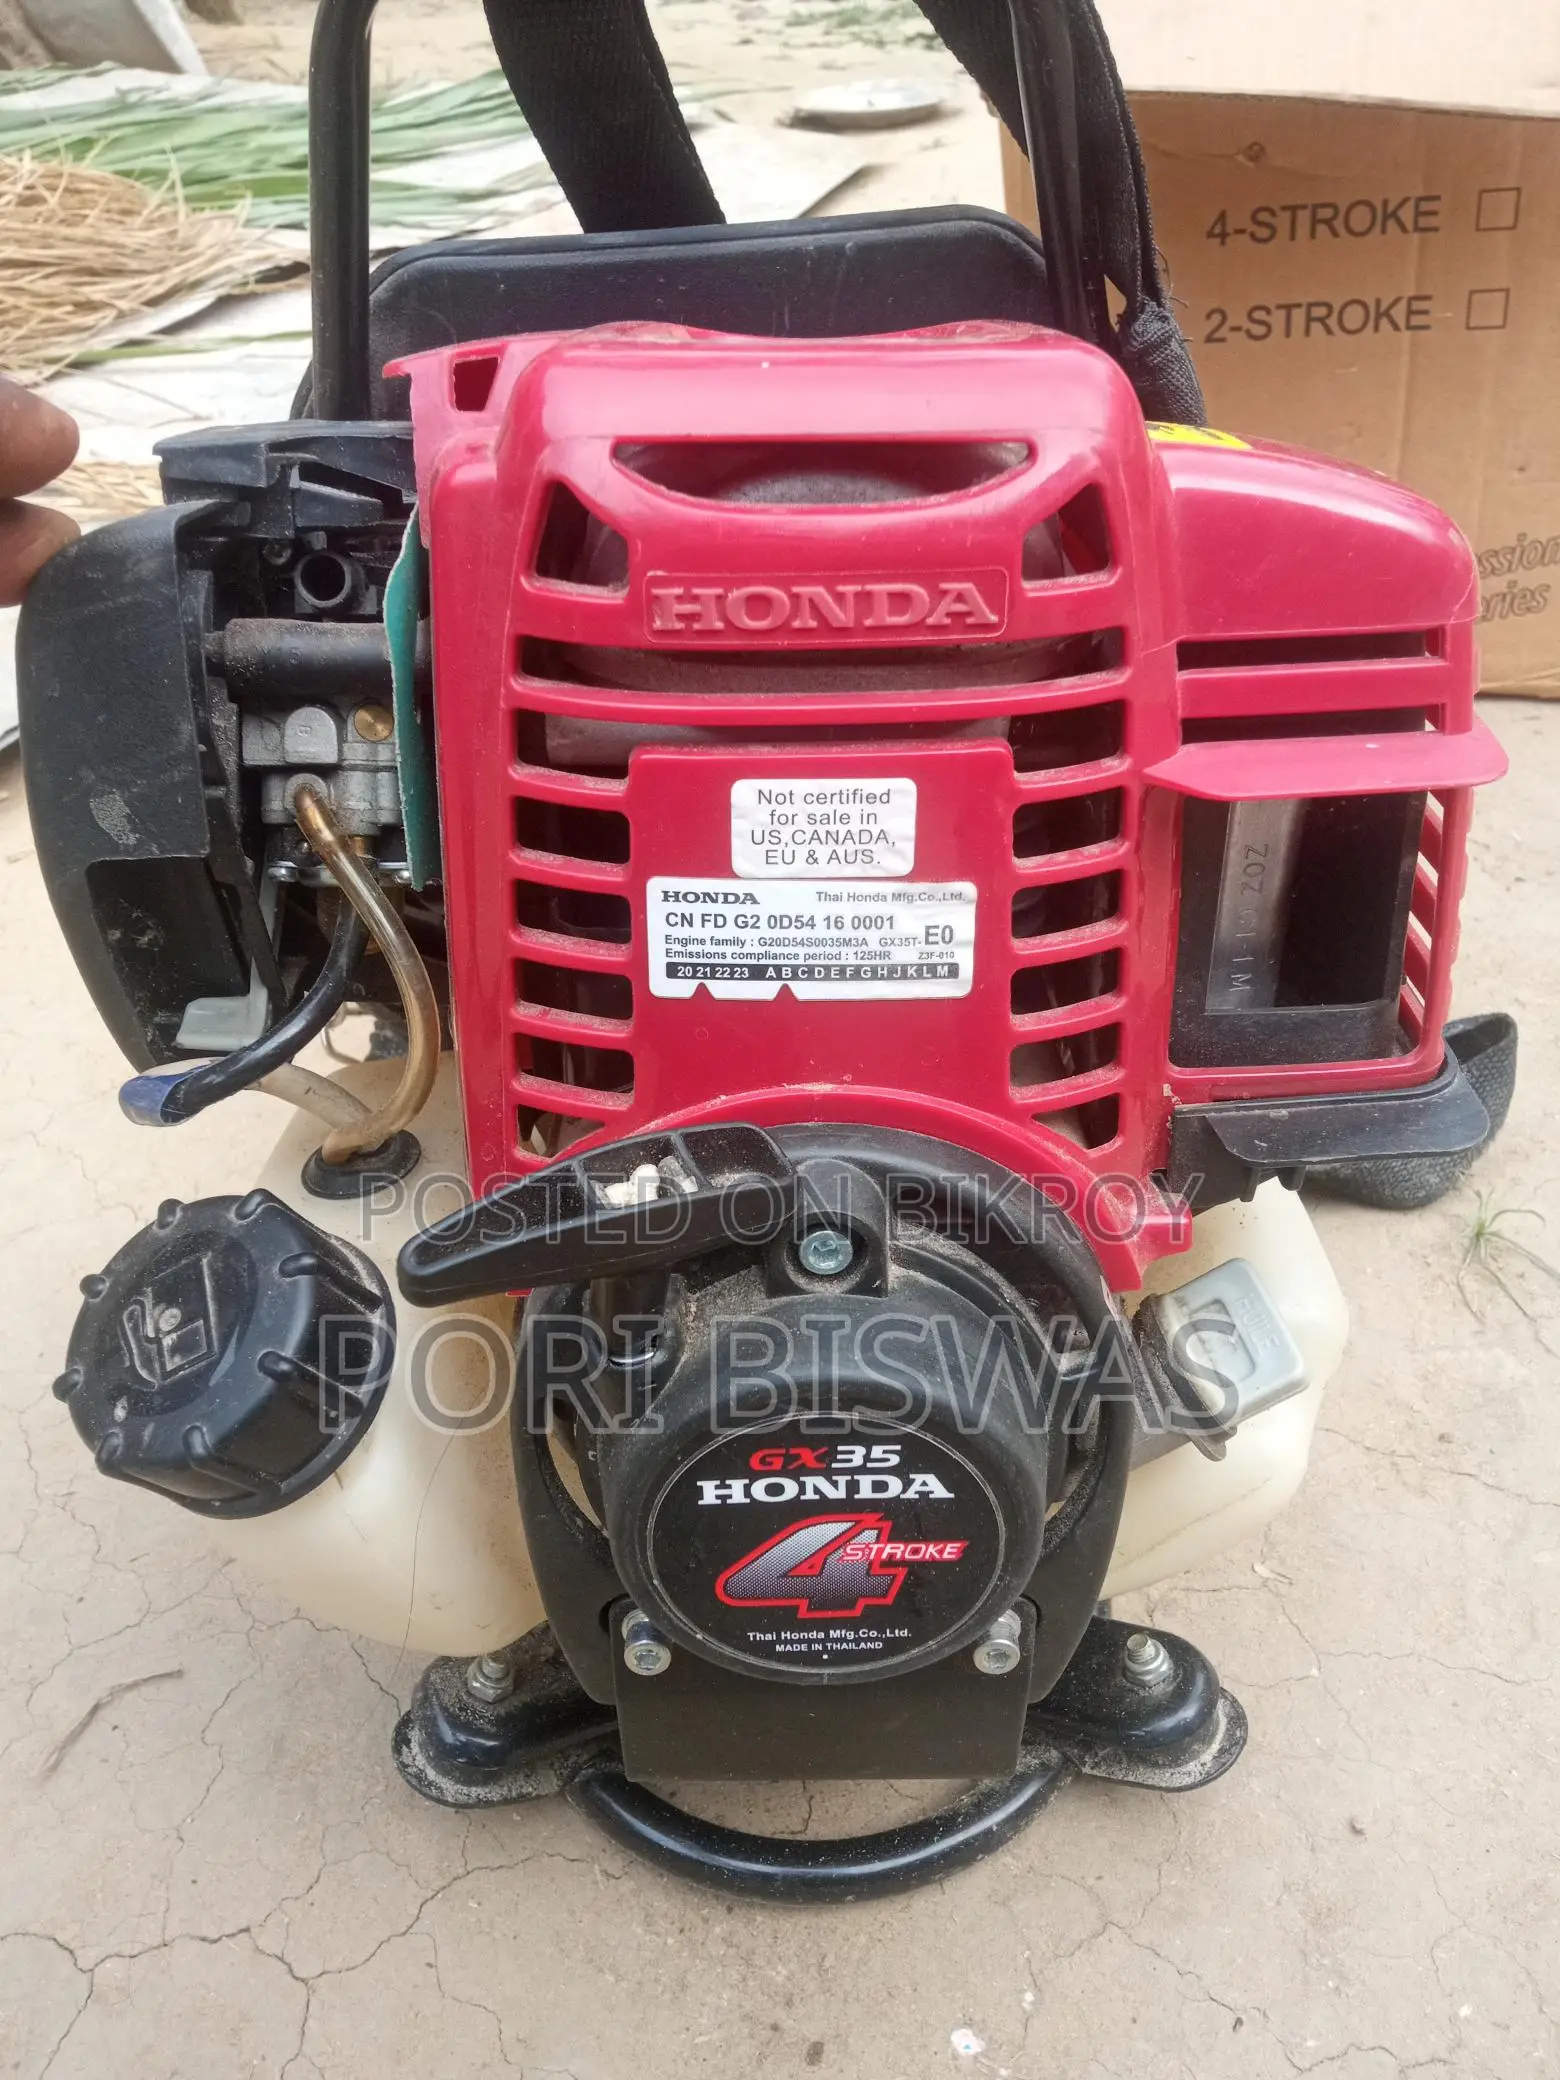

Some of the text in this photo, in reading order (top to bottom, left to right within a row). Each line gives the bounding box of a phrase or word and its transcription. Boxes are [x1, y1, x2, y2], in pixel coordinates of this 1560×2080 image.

[1205, 194, 1442, 247] 4-STROKE
[1203, 294, 1434, 344] 2-STROKE
[1476, 531, 1560, 580] ssion
[651, 581, 999, 632] HONDA
[757, 787, 891, 806] Not certified
[769, 808, 878, 826] for sale in
[750, 829, 898, 850] US,CANADA,
[765, 848, 882, 866] EU & AUS.
[661, 890, 967, 906] HONDA Thai Honda Mfg.Co.,Ltd.
[665, 912, 896, 931] CN FD G2 0D54 16 0001
[665, 934, 707, 948] Engine
[709, 935, 747, 948] family
[758, 936, 869, 948] G20D54S0035M3A
[665, 948, 727, 960] Emissions
[731, 950, 800, 962] compliance
[803, 950, 842, 963] period
[853, 950, 892, 961] 125HR
[765, 966, 777, 979] A
[781, 966, 792, 979] B
[797, 966, 809, 979] C
[814, 966, 825, 979] D
[830, 966, 840, 979] E
[845, 966, 855, 979] F
[860, 966, 872, 979] G
[877, 966, 888, 979] H
[892, 966, 901, 979] J
[907, 966, 918, 979] K
[922, 966, 932, 979] L
[936, 965, 949, 977] M
[749, 1444, 902, 1472] GX35
[697, 1473, 956, 1505] HONDA
[715, 1513, 964, 1619] 4 STROKE
[747, 1628, 912, 1641] Thai Honda Mfg.Co.,Ltd.
[775, 1641, 883, 1652] MADE IN THAILAND
